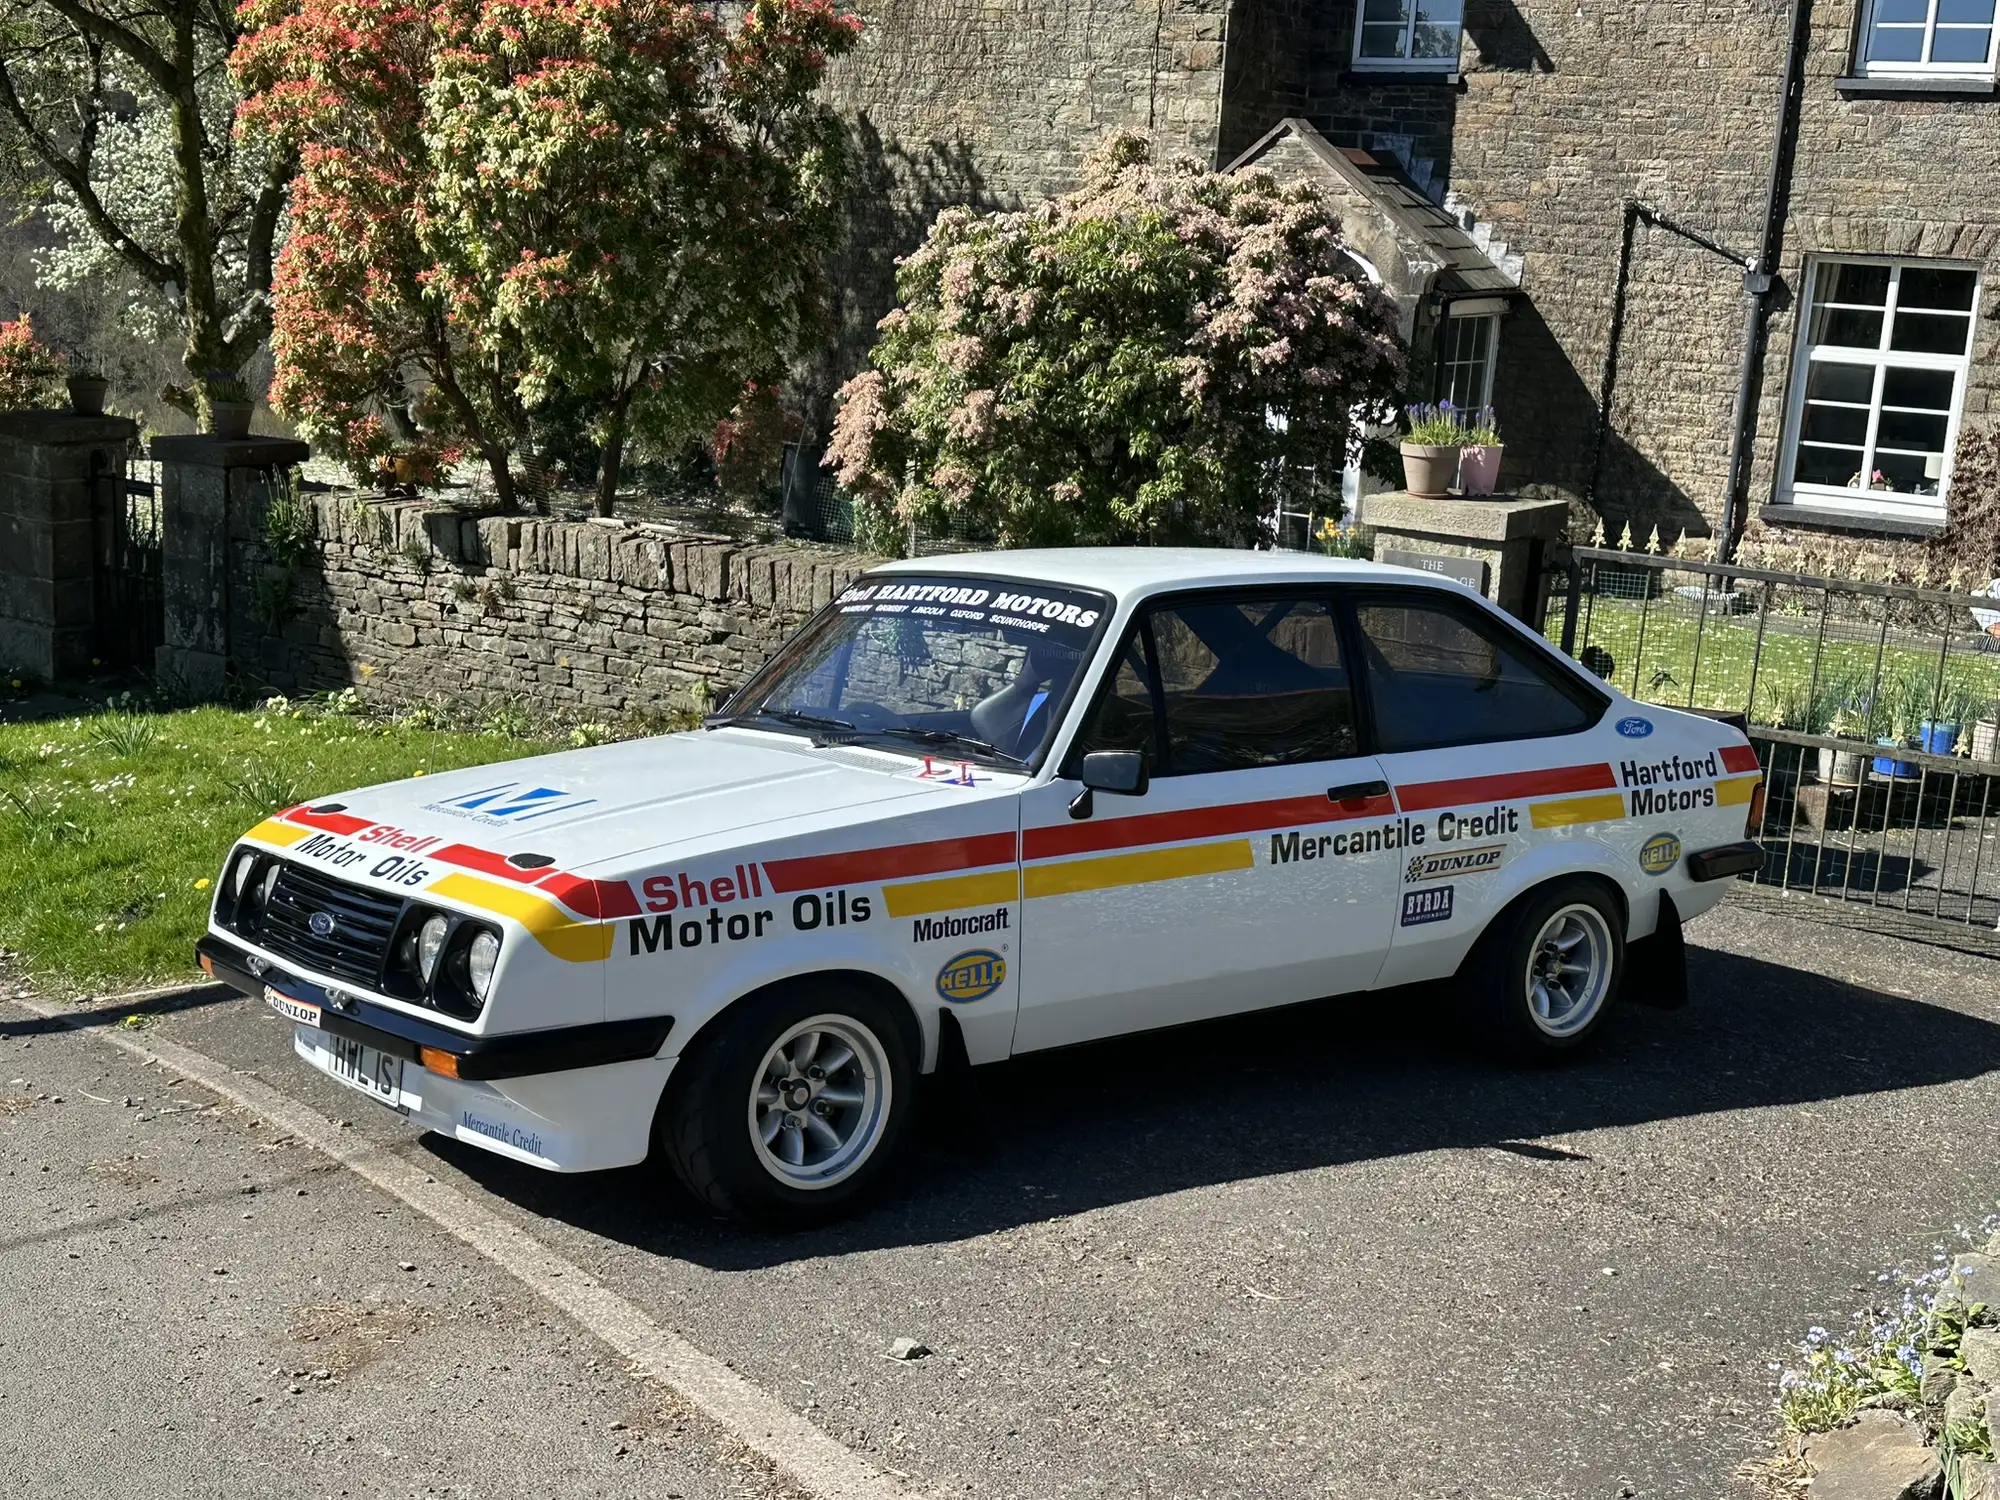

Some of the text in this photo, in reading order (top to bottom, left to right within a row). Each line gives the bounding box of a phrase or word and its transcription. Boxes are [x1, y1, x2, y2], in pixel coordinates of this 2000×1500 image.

[1421, 560, 1444, 571] THE
[873, 584, 989, 606] HARTFORD
[989, 590, 1099, 628] MOTORS
[911, 606, 947, 616] LINCOLN
[950, 609, 985, 620] OXFORD
[989, 614, 1050, 633] SCUNTHORPE
[1624, 720, 1647, 734] Ford
[1620, 752, 1718, 787] Hartford
[1632, 787, 1714, 817] Motors
[359, 825, 443, 853] Shell
[1271, 806, 1519, 865] Mercantile Credit
[294, 834, 429, 886] Motor Oils
[1424, 850, 1502, 874] DUNLOP
[642, 862, 762, 914] Shell
[1406, 890, 1450, 915] BTRDA
[629, 890, 872, 957] Motor Oils
[913, 907, 1010, 943] Motorcraft
[940, 961, 1005, 991] HELLA
[273, 996, 317, 1022] DUNLOP
[462, 1111, 543, 1155] Mercantile Credit
